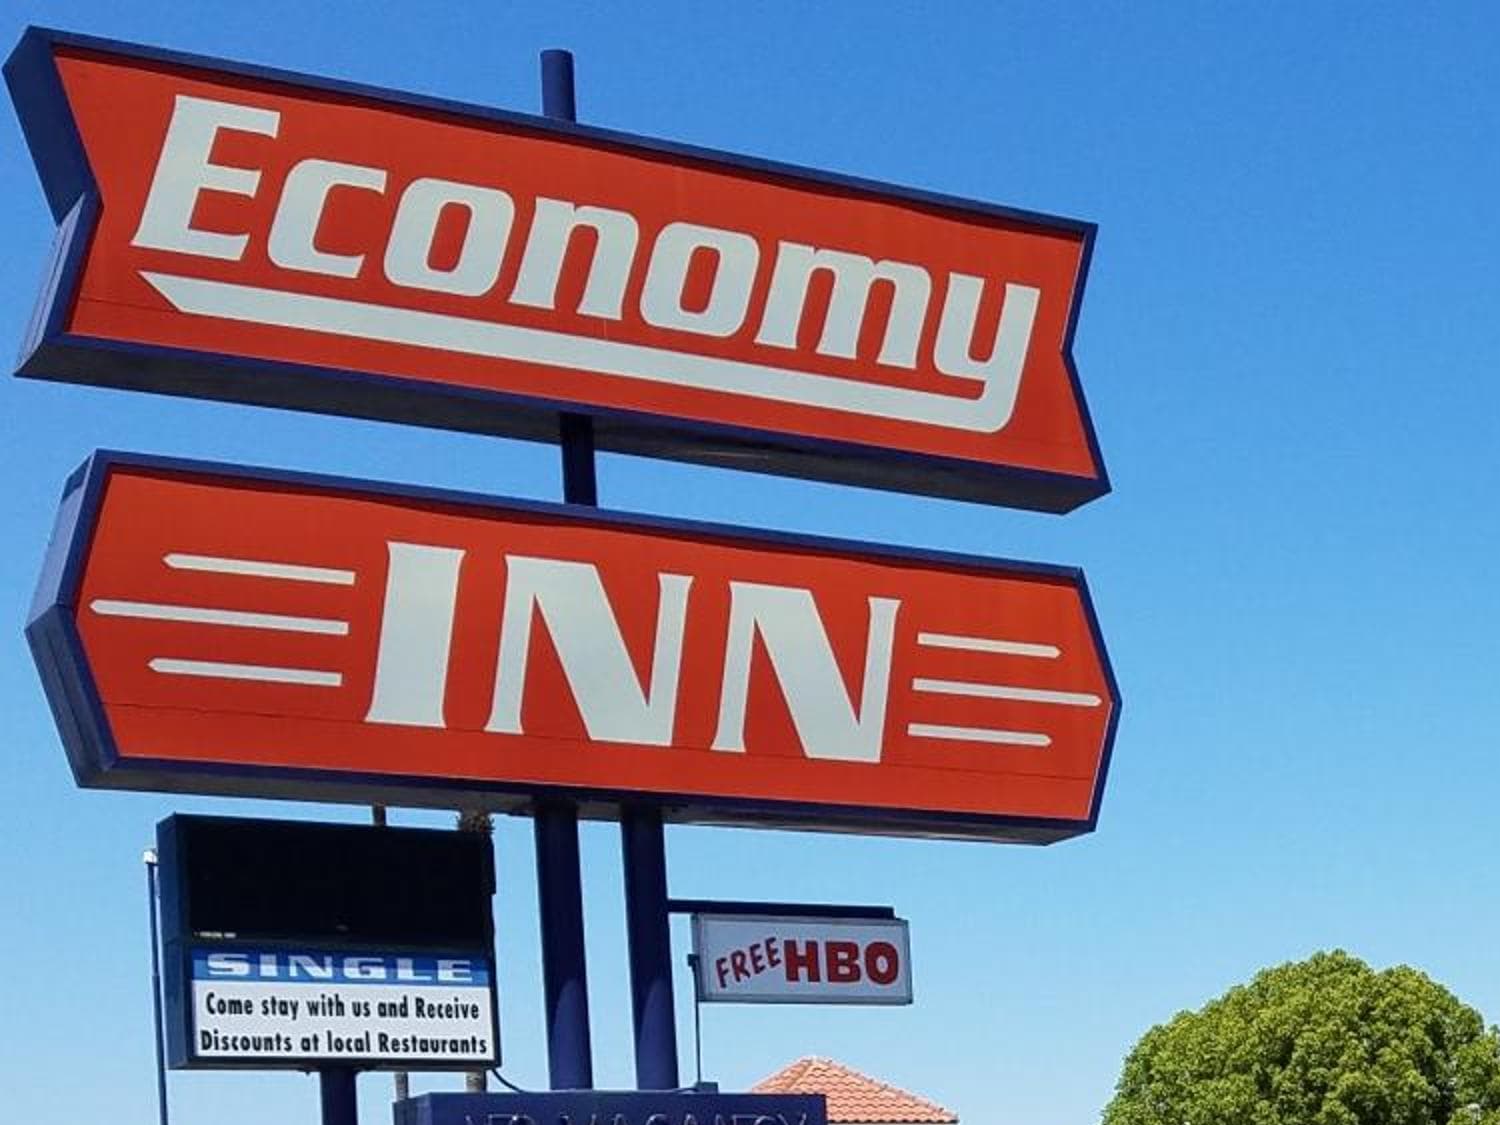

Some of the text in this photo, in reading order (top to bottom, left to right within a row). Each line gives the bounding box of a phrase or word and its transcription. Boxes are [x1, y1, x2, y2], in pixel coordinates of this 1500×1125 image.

[130, 94, 1042, 433] Economy
[365, 541, 901, 764] INN
[207, 953, 473, 982] SINGLE
[716, 937, 899, 988] FREE HBO
[205, 992, 480, 1020] Come stay with us and Receive
[200, 1029, 487, 1055] Discounts at local Restaurants
